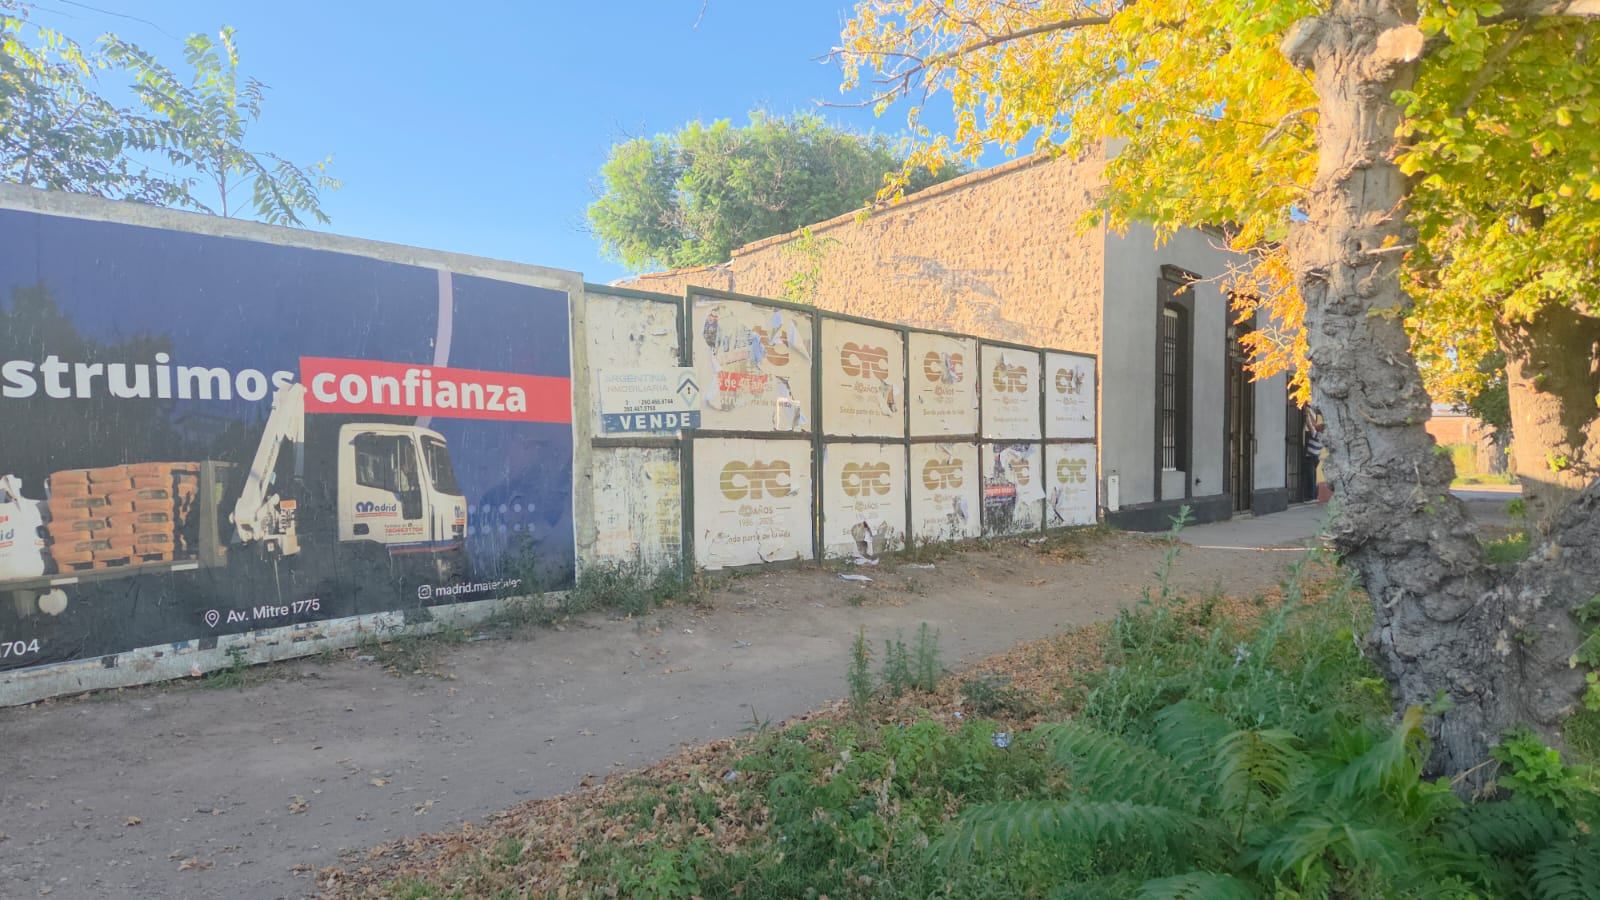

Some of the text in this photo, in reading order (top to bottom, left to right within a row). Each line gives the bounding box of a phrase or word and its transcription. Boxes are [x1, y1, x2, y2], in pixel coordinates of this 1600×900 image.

[923, 351, 963, 382] CC
[312, 368, 527, 412] confianza
[619, 412, 691, 430] VENDE
[355, 501, 397, 512] Madrid
[226, 598, 321, 624] Av. Mitre 1775
[1, 638, 40, 658] 704
